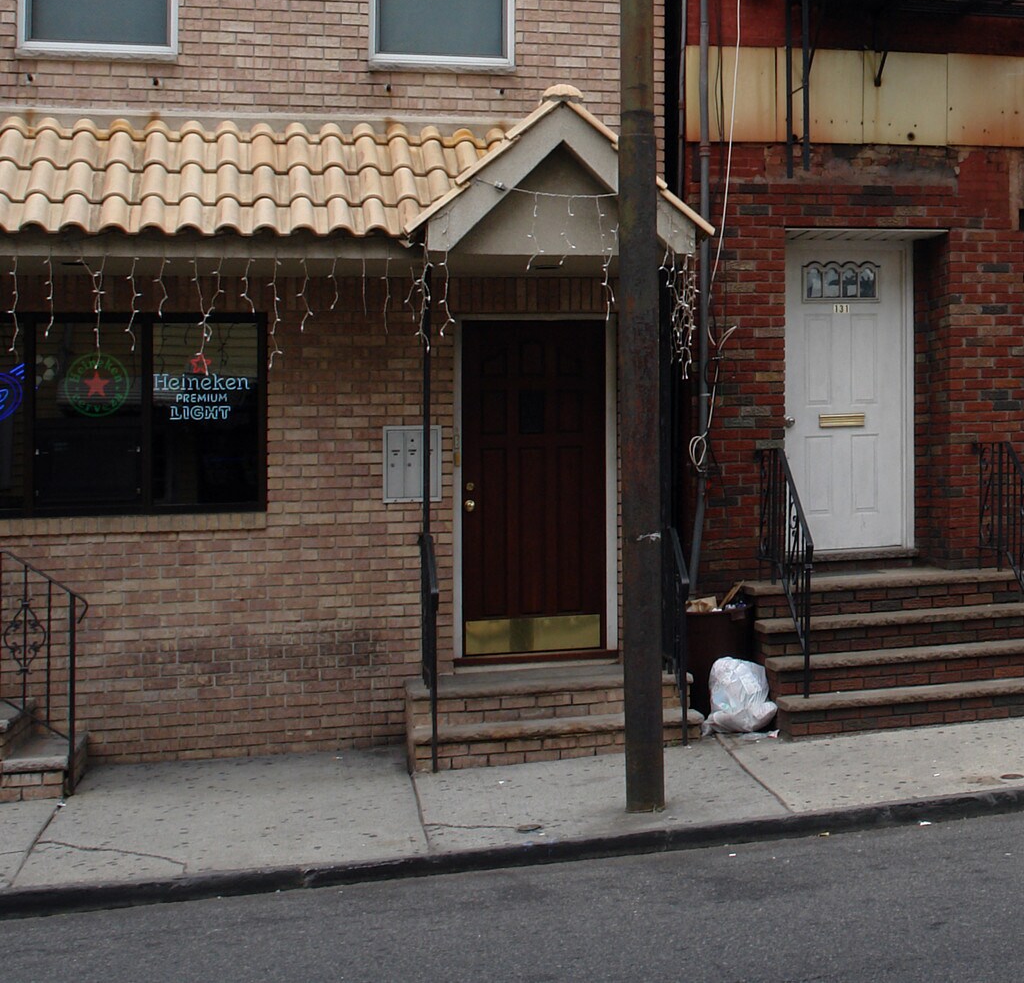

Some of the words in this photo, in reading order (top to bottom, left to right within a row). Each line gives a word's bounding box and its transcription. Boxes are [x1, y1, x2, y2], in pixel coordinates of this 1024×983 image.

[834, 304, 849, 313] 131
[152, 373, 250, 391] Heineken
[175, 393, 228, 403] PREMIUM
[169, 405, 231, 420] LIGHT
